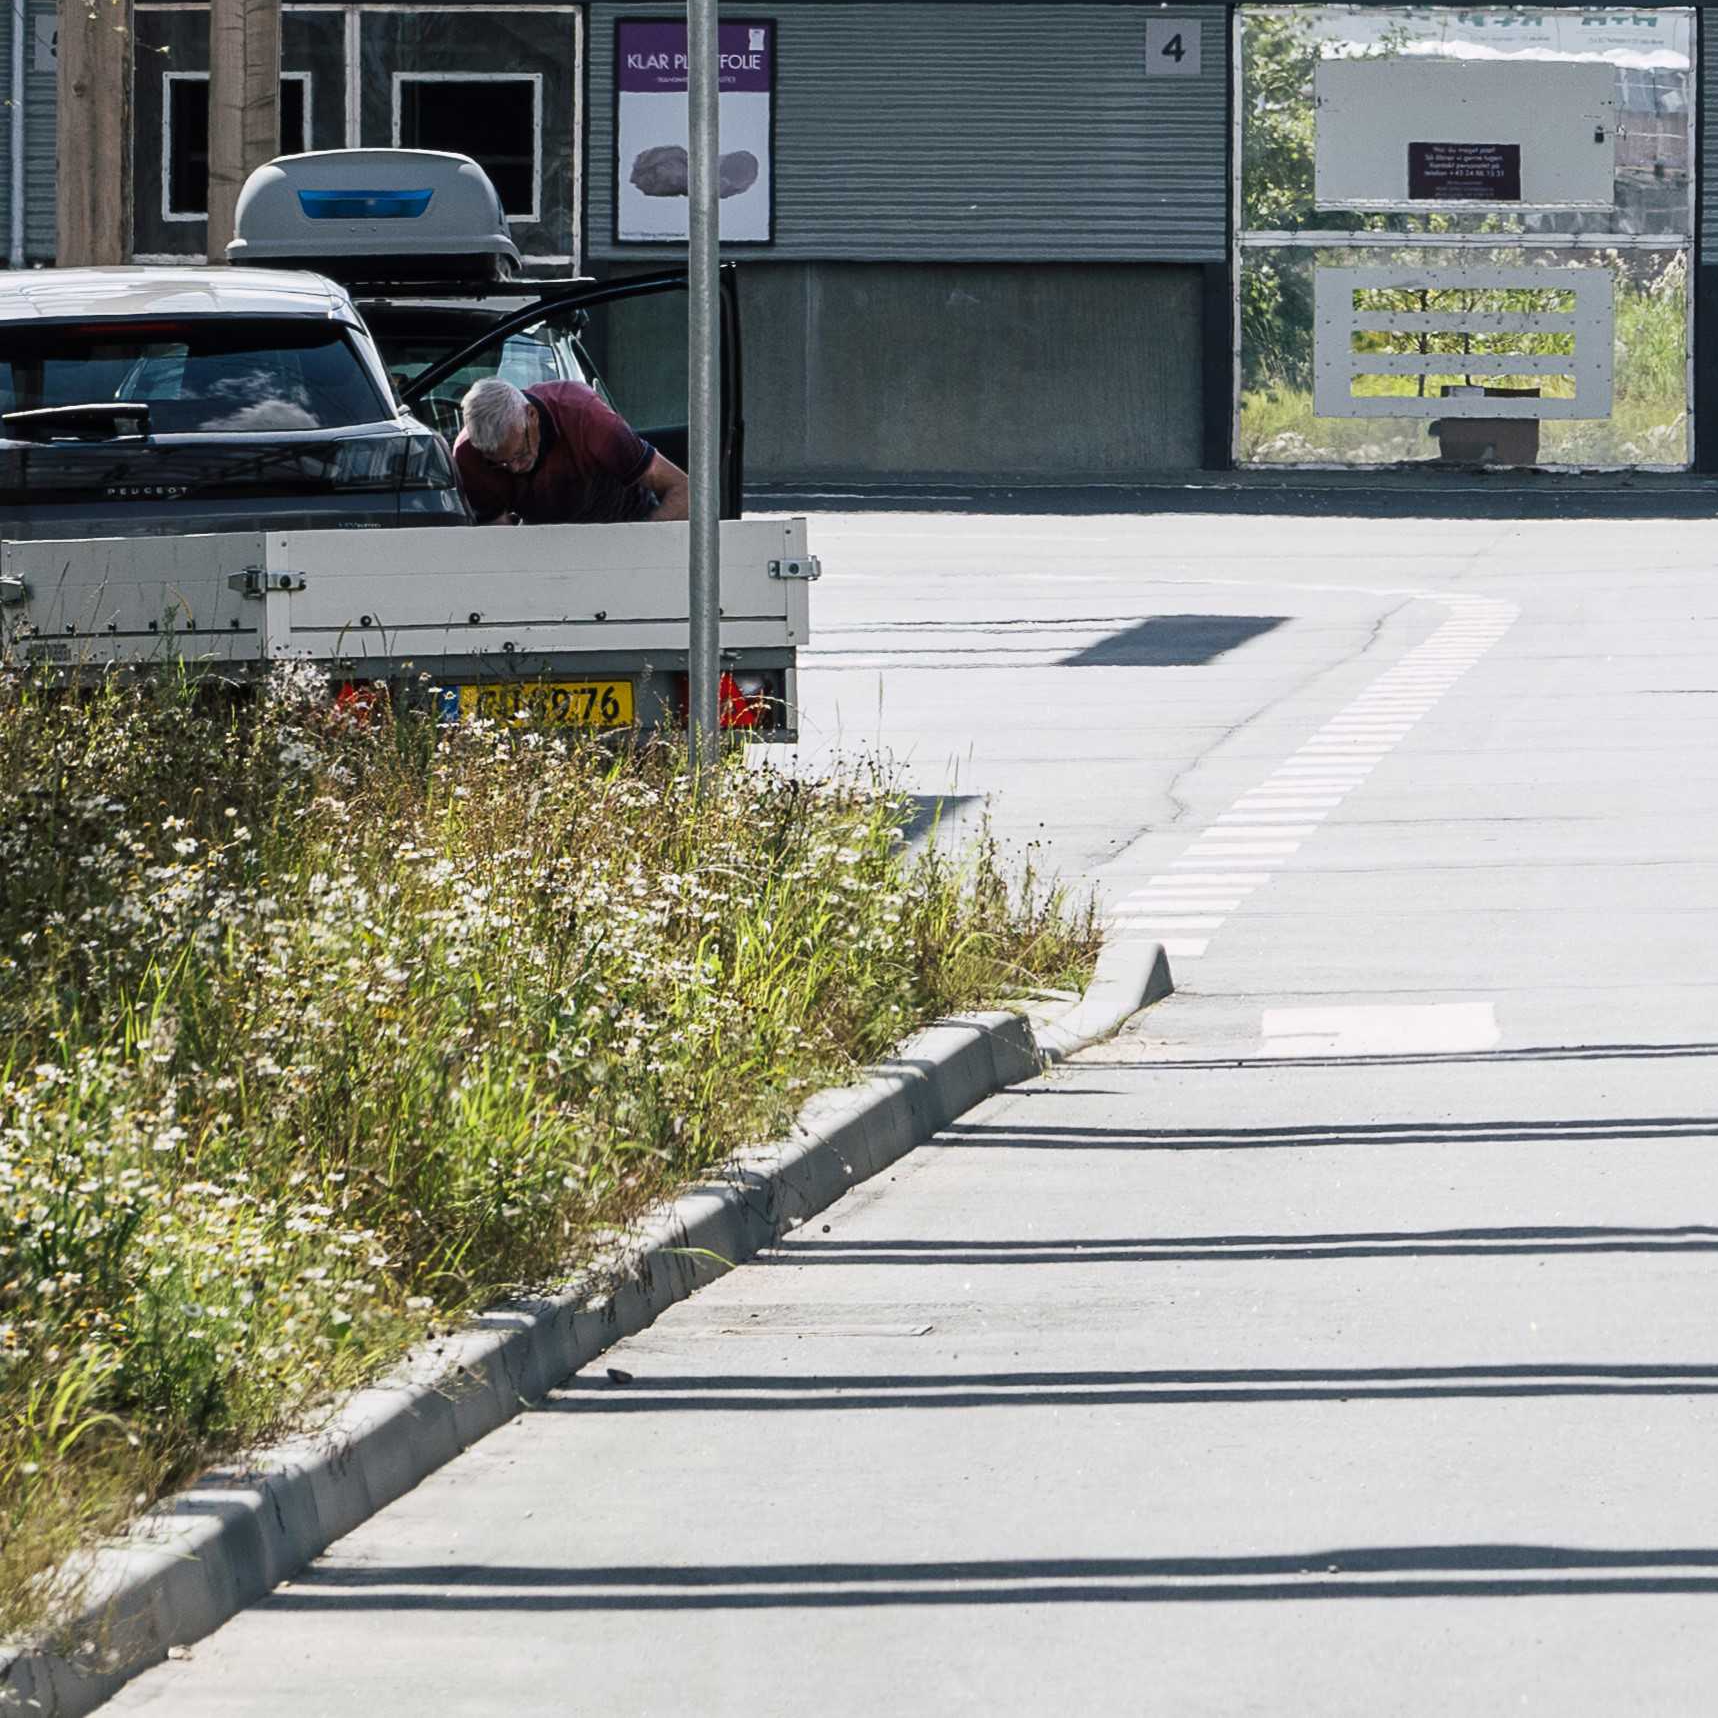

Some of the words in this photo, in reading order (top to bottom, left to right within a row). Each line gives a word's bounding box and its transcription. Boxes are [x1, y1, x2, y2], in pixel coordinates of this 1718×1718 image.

[1161, 33, 1186, 63] 4
[627, 53, 670, 70] KLAR
[674, 53, 761, 70] PLFOLIE
[107, 486, 188, 496] PEUGEOT
